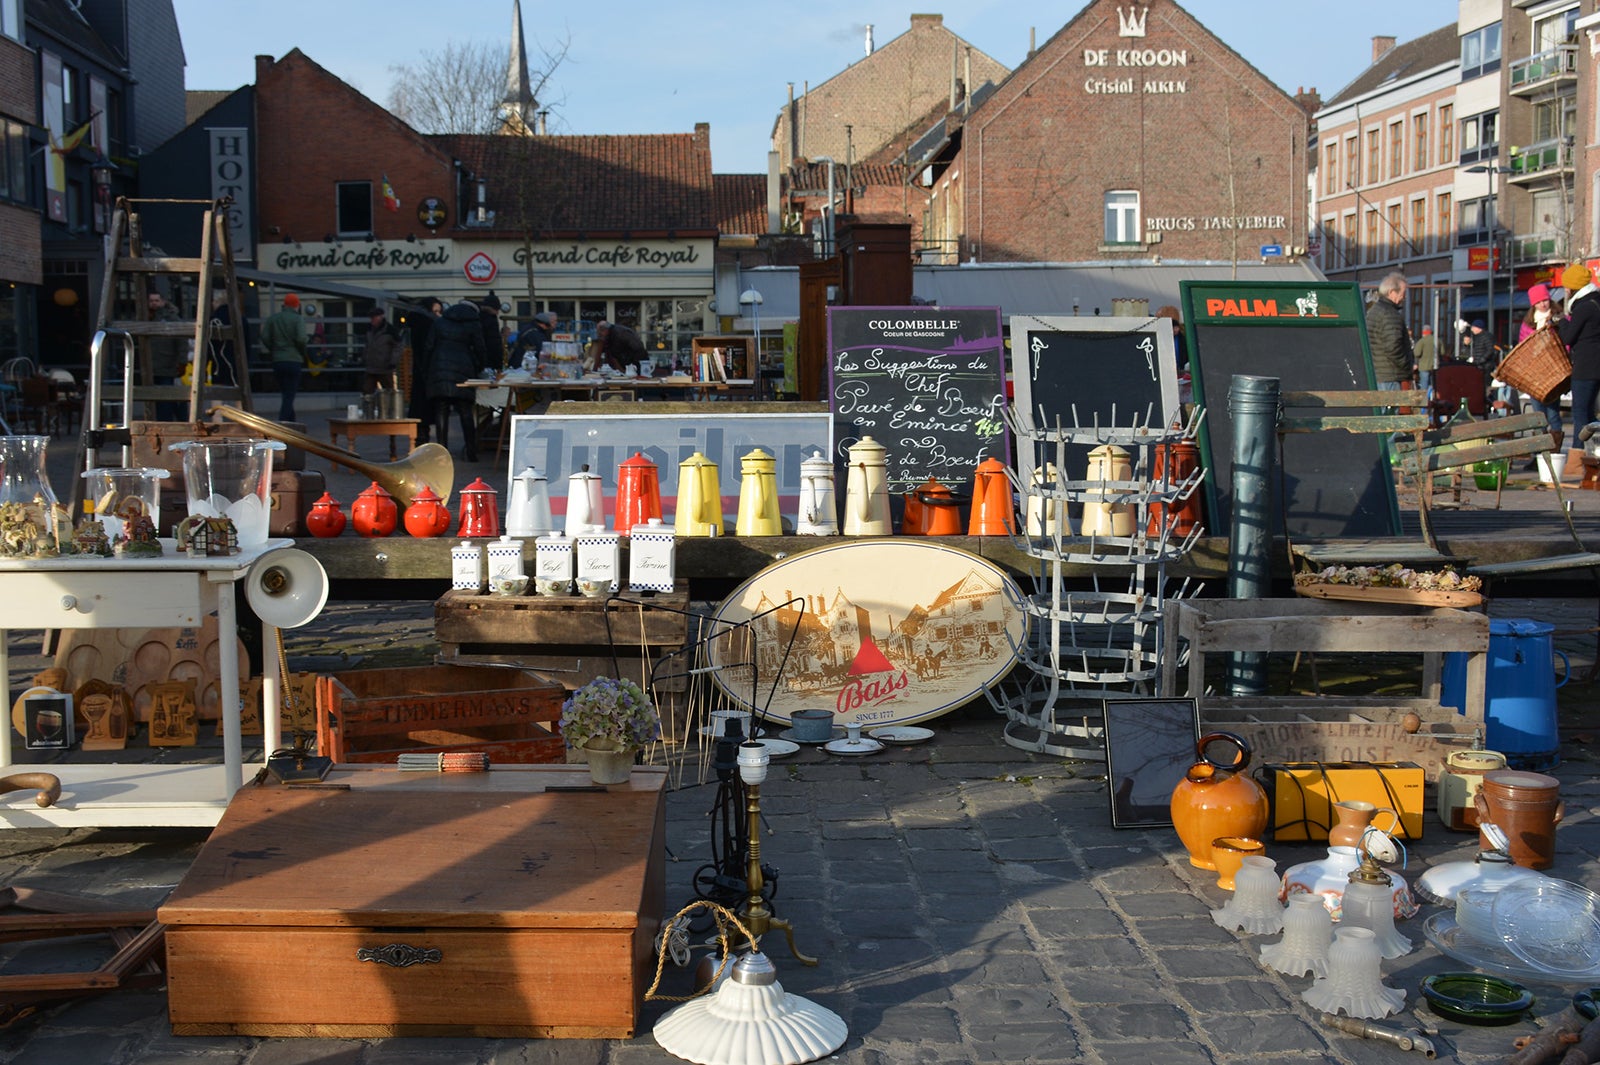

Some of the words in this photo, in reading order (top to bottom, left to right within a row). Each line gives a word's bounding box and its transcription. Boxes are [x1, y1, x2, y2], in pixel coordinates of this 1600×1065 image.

[1084, 49, 1109, 67] DE
[1116, 49, 1188, 67] KROON
[1143, 80, 1187, 94] ALKEN
[216, 136, 244, 253] HOTE
[1146, 216, 1196, 231] BRUGS
[1202, 215, 1287, 230] TARWEBIER
[276, 248, 342, 269] Grand
[343, 247, 388, 269] Café
[390, 246, 449, 269] Royal
[585, 245, 634, 267] Café
[635, 245, 699, 269] Royal
[1206, 298, 1278, 317] PALM
[868, 319, 959, 330] COLOMBELLE
[833, 351, 859, 372] Les
[864, 348, 958, 379] Suggestions
[967, 356, 989, 371] du
[904, 372, 951, 400] Chef
[835, 380, 894, 414] Pavé
[903, 395, 926, 413] de
[937, 387, 1006, 419] Boeuf
[853, 416, 876, 427] en
[889, 410, 972, 432] Emincé
[899, 452, 920, 466] de
[926, 444, 989, 468] Boeuf
[836, 669, 908, 714] Bass
[383, 697, 532, 723] TIMMERMANS
[856, 711, 878, 721] SINCE
[880, 710, 894, 720] 1777
